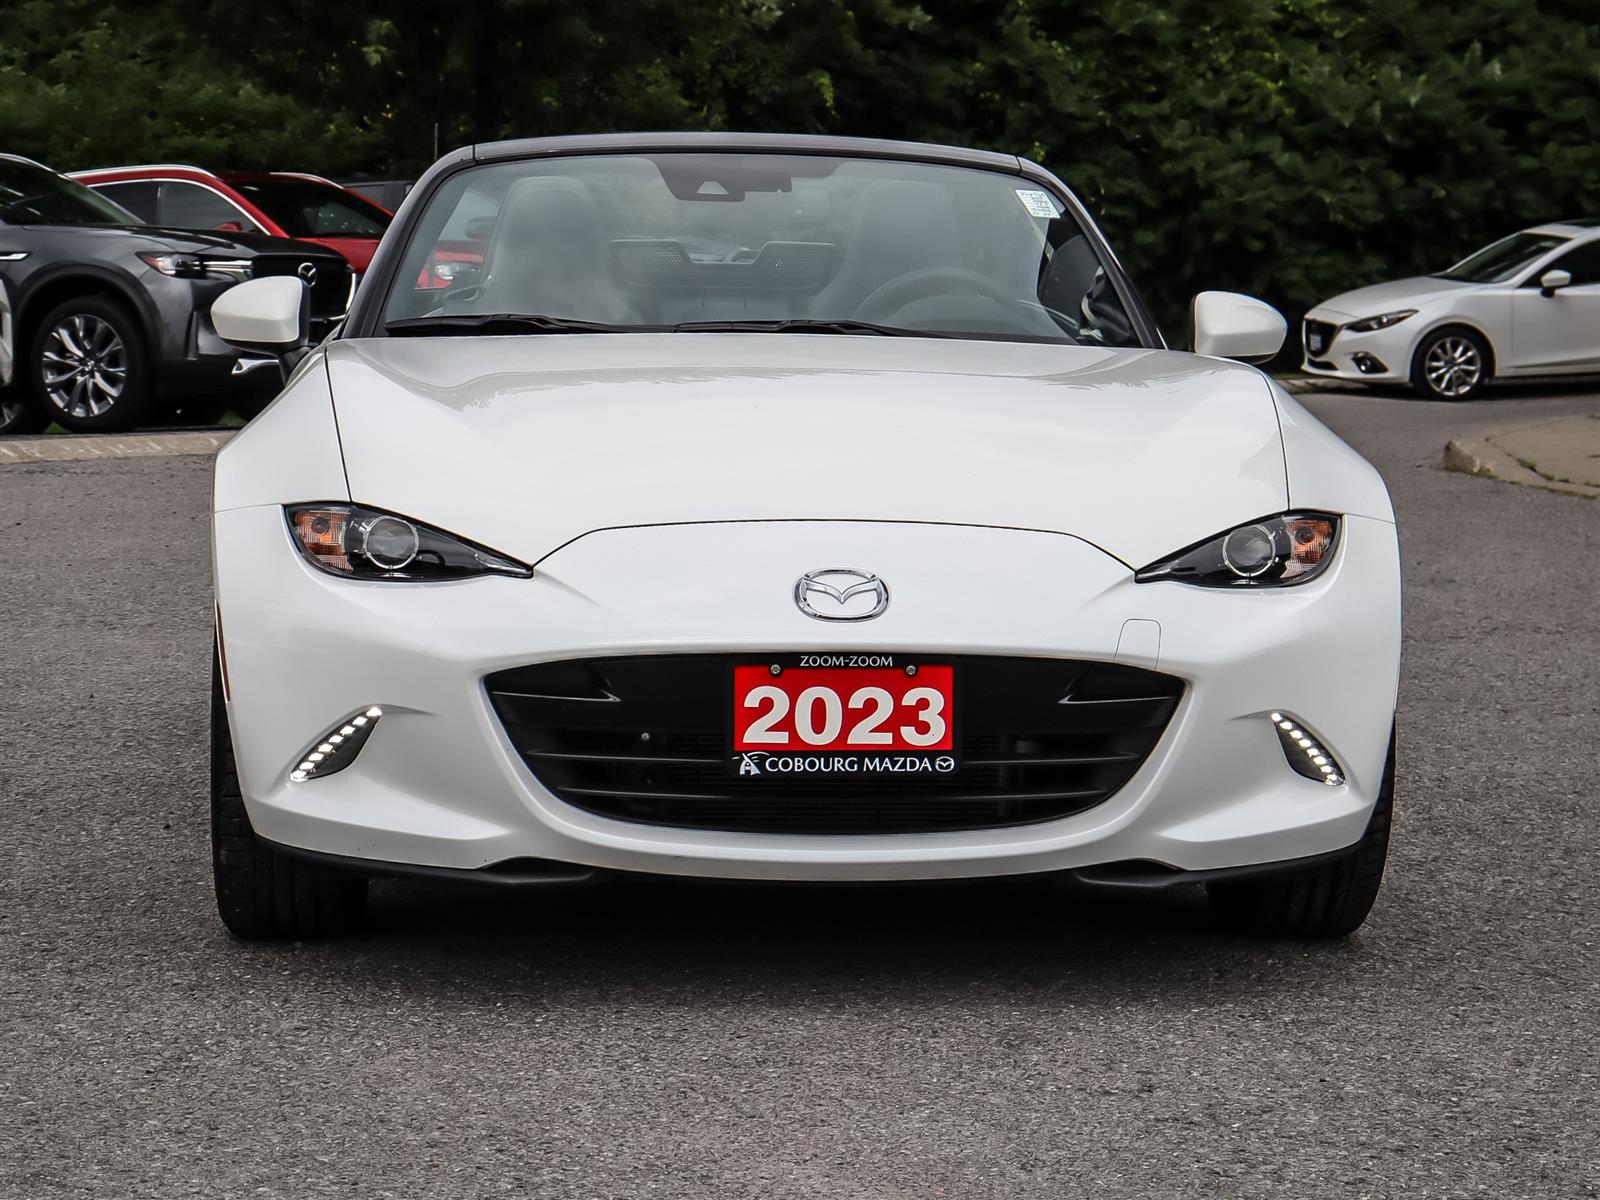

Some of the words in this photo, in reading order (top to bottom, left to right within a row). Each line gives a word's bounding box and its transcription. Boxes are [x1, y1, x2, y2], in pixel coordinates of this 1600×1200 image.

[800, 655, 893, 667] ZOOM-ZOOM
[742, 685, 946, 746] 2023
[765, 756, 858, 772] COBOURG
[863, 756, 933, 772] MAZDA
